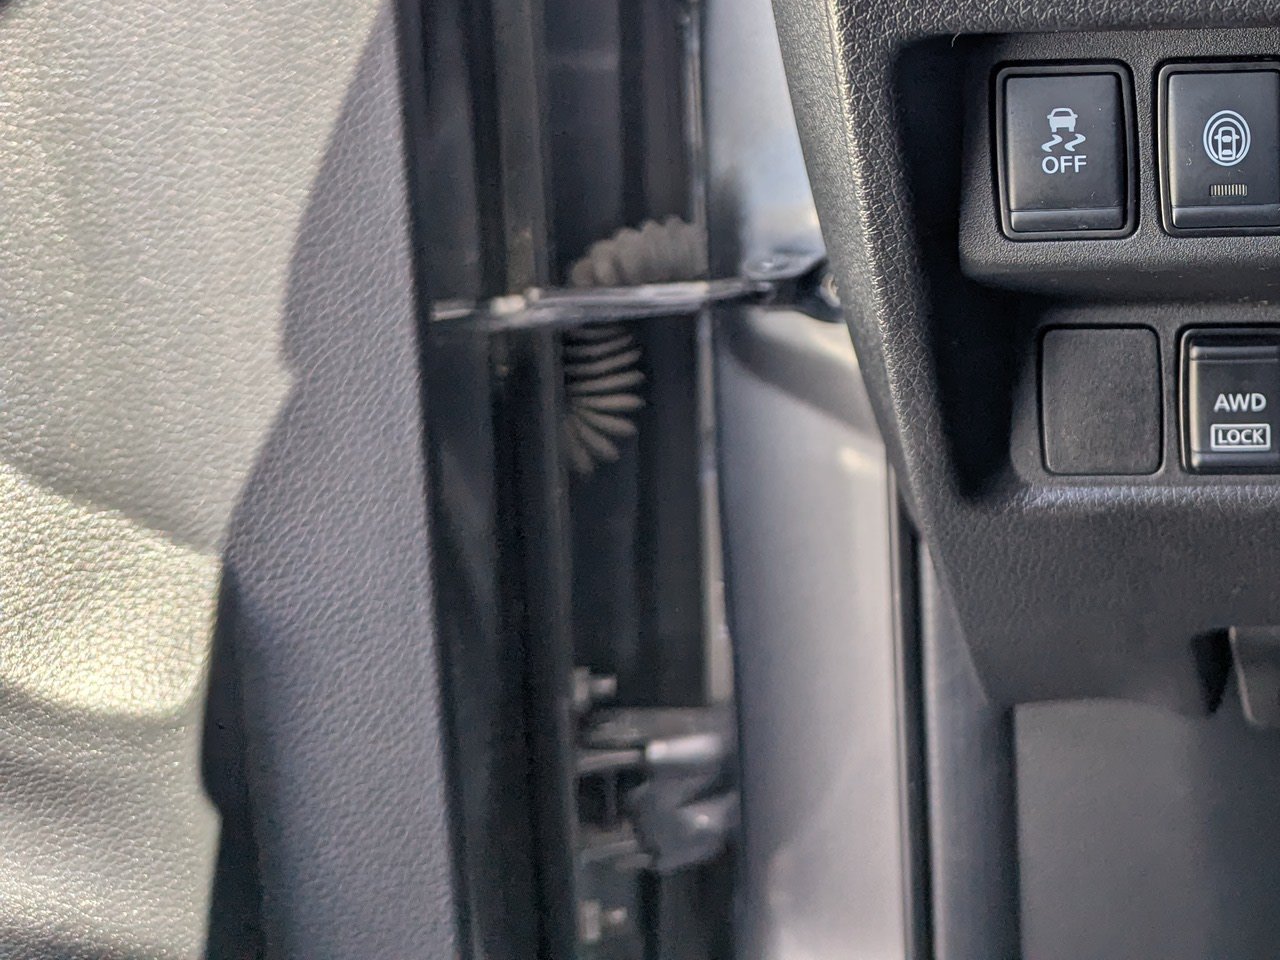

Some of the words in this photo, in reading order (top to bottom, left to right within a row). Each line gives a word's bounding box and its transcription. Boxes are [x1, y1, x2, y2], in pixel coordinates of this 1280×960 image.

[1041, 154, 1087, 175] OFF
[1213, 391, 1267, 413] AWD
[1217, 427, 1264, 446] LOCK
